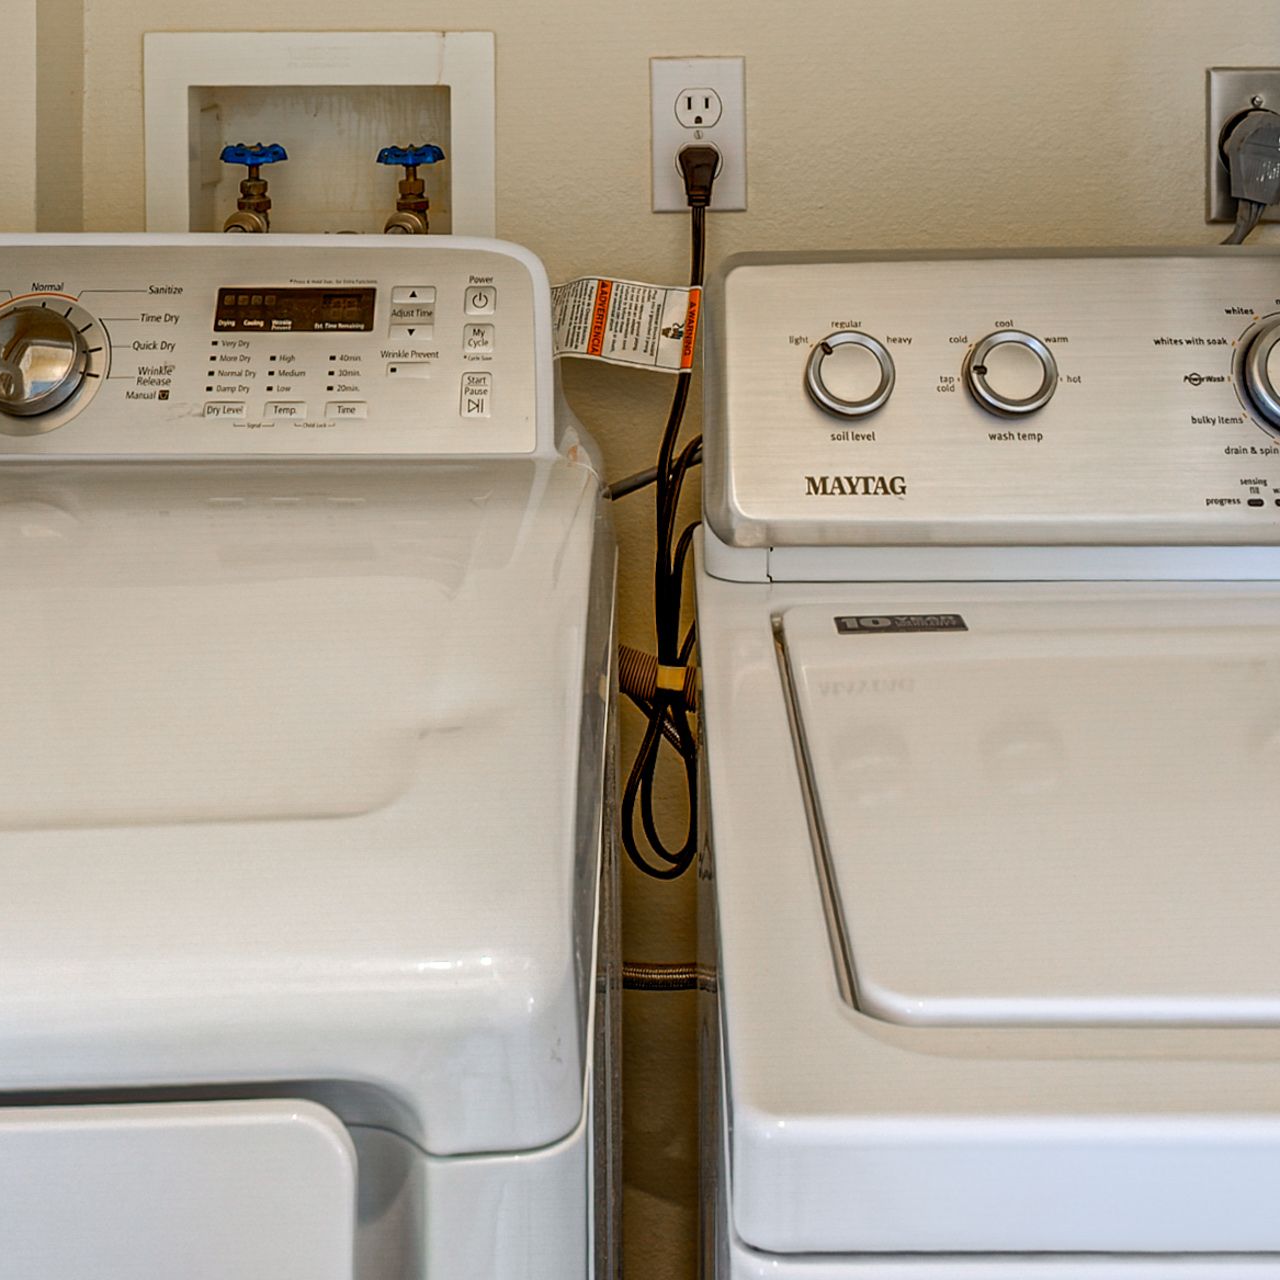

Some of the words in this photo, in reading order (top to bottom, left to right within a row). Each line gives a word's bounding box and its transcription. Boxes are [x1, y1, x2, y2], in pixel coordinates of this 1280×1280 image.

[469, 275, 494, 284] Power
[31, 282, 65, 291] Normal
[148, 285, 184, 295] Sanitize
[391, 308, 415, 319] Adjust
[415, 308, 433, 317] Time
[1224, 306, 1254, 315] whites
[140, 313, 159, 323] Time
[160, 313, 180, 325] Dry
[589, 290, 609, 353] ADVERTENCIA
[994, 319, 1014, 329] cool
[831, 320, 862, 329] regular
[472, 328, 486, 338] My
[683, 306, 697, 357] WARNING
[467, 338, 489, 349] Cycle
[789, 335, 809, 345] light
[886, 336, 912, 345] heavy
[949, 335, 968, 344] cold
[1044, 336, 1069, 344] warm
[1153, 337, 1183, 346] whites
[1184, 337, 1205, 346] with
[1206, 337, 1228, 346] soak
[132, 341, 157, 351] Quick
[157, 341, 176, 353] Dry
[279, 354, 296, 364] High
[380, 350, 410, 360] Wrinkle
[410, 350, 440, 360] Prevent
[137, 366, 173, 376] Wrinkle
[278, 369, 306, 377] Medium
[136, 376, 172, 386] Release
[467, 376, 486, 385] Start
[939, 375, 955, 385] tap
[1066, 375, 1082, 384] hot
[276, 385, 291, 393] Low
[464, 386, 488, 396] Pause
[936, 384, 956, 393] cold
[125, 390, 156, 400] Manual
[206, 405, 221, 417] Dry
[222, 405, 244, 415] Level
[337, 405, 356, 415] Time
[1191, 415, 1216, 426] bulky
[1217, 415, 1244, 425] items
[830, 431, 850, 442] soil
[851, 431, 876, 442] level
[988, 431, 1015, 441] wash
[1017, 432, 1044, 443] temp
[1224, 446, 1248, 455] drain
[1259, 446, 1280, 457] spin
[805, 476, 907, 496] MAYTAG
